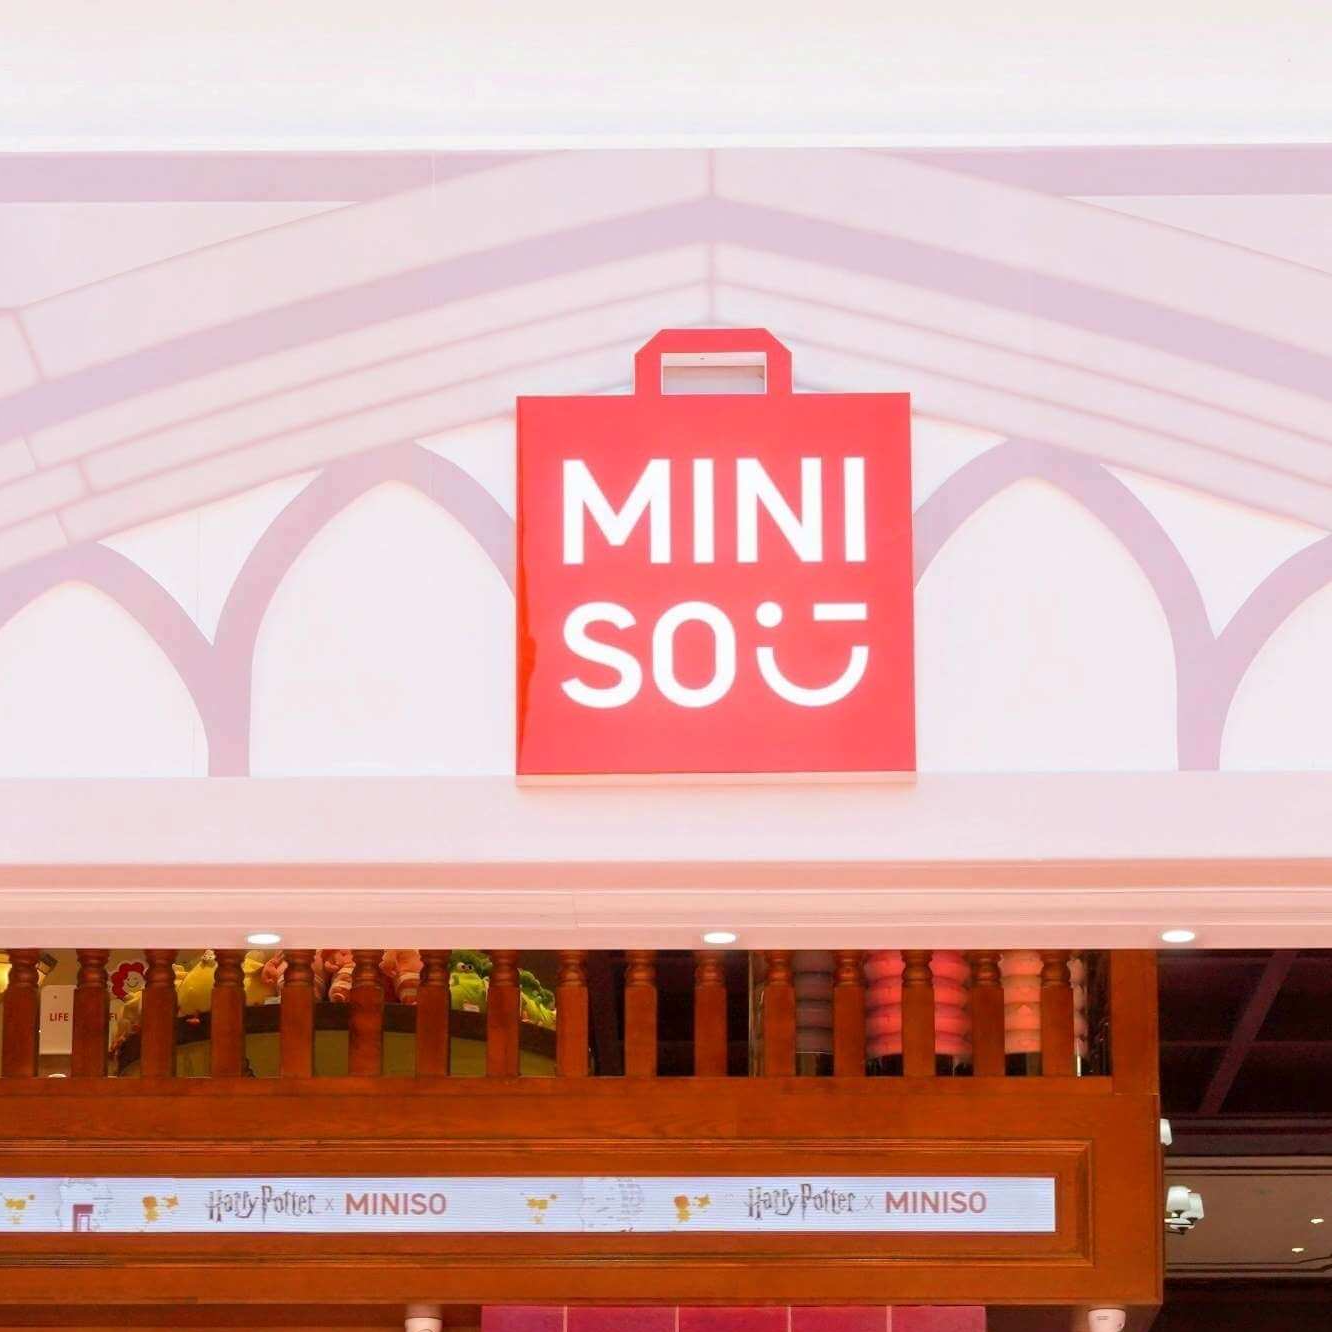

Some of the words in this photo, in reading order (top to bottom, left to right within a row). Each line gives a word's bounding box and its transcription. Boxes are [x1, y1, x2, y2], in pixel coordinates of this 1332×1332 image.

[562, 456, 868, 566] MINI
[48, 1012, 70, 1023] LIFE
[206, 1188, 258, 1223] Harry
[260, 1184, 317, 1224] Potter
[344, 1192, 447, 1215] MINISO
[747, 1186, 798, 1221] Harry
[799, 1183, 856, 1222] Potter
[884, 1190, 988, 1215] MINISO
